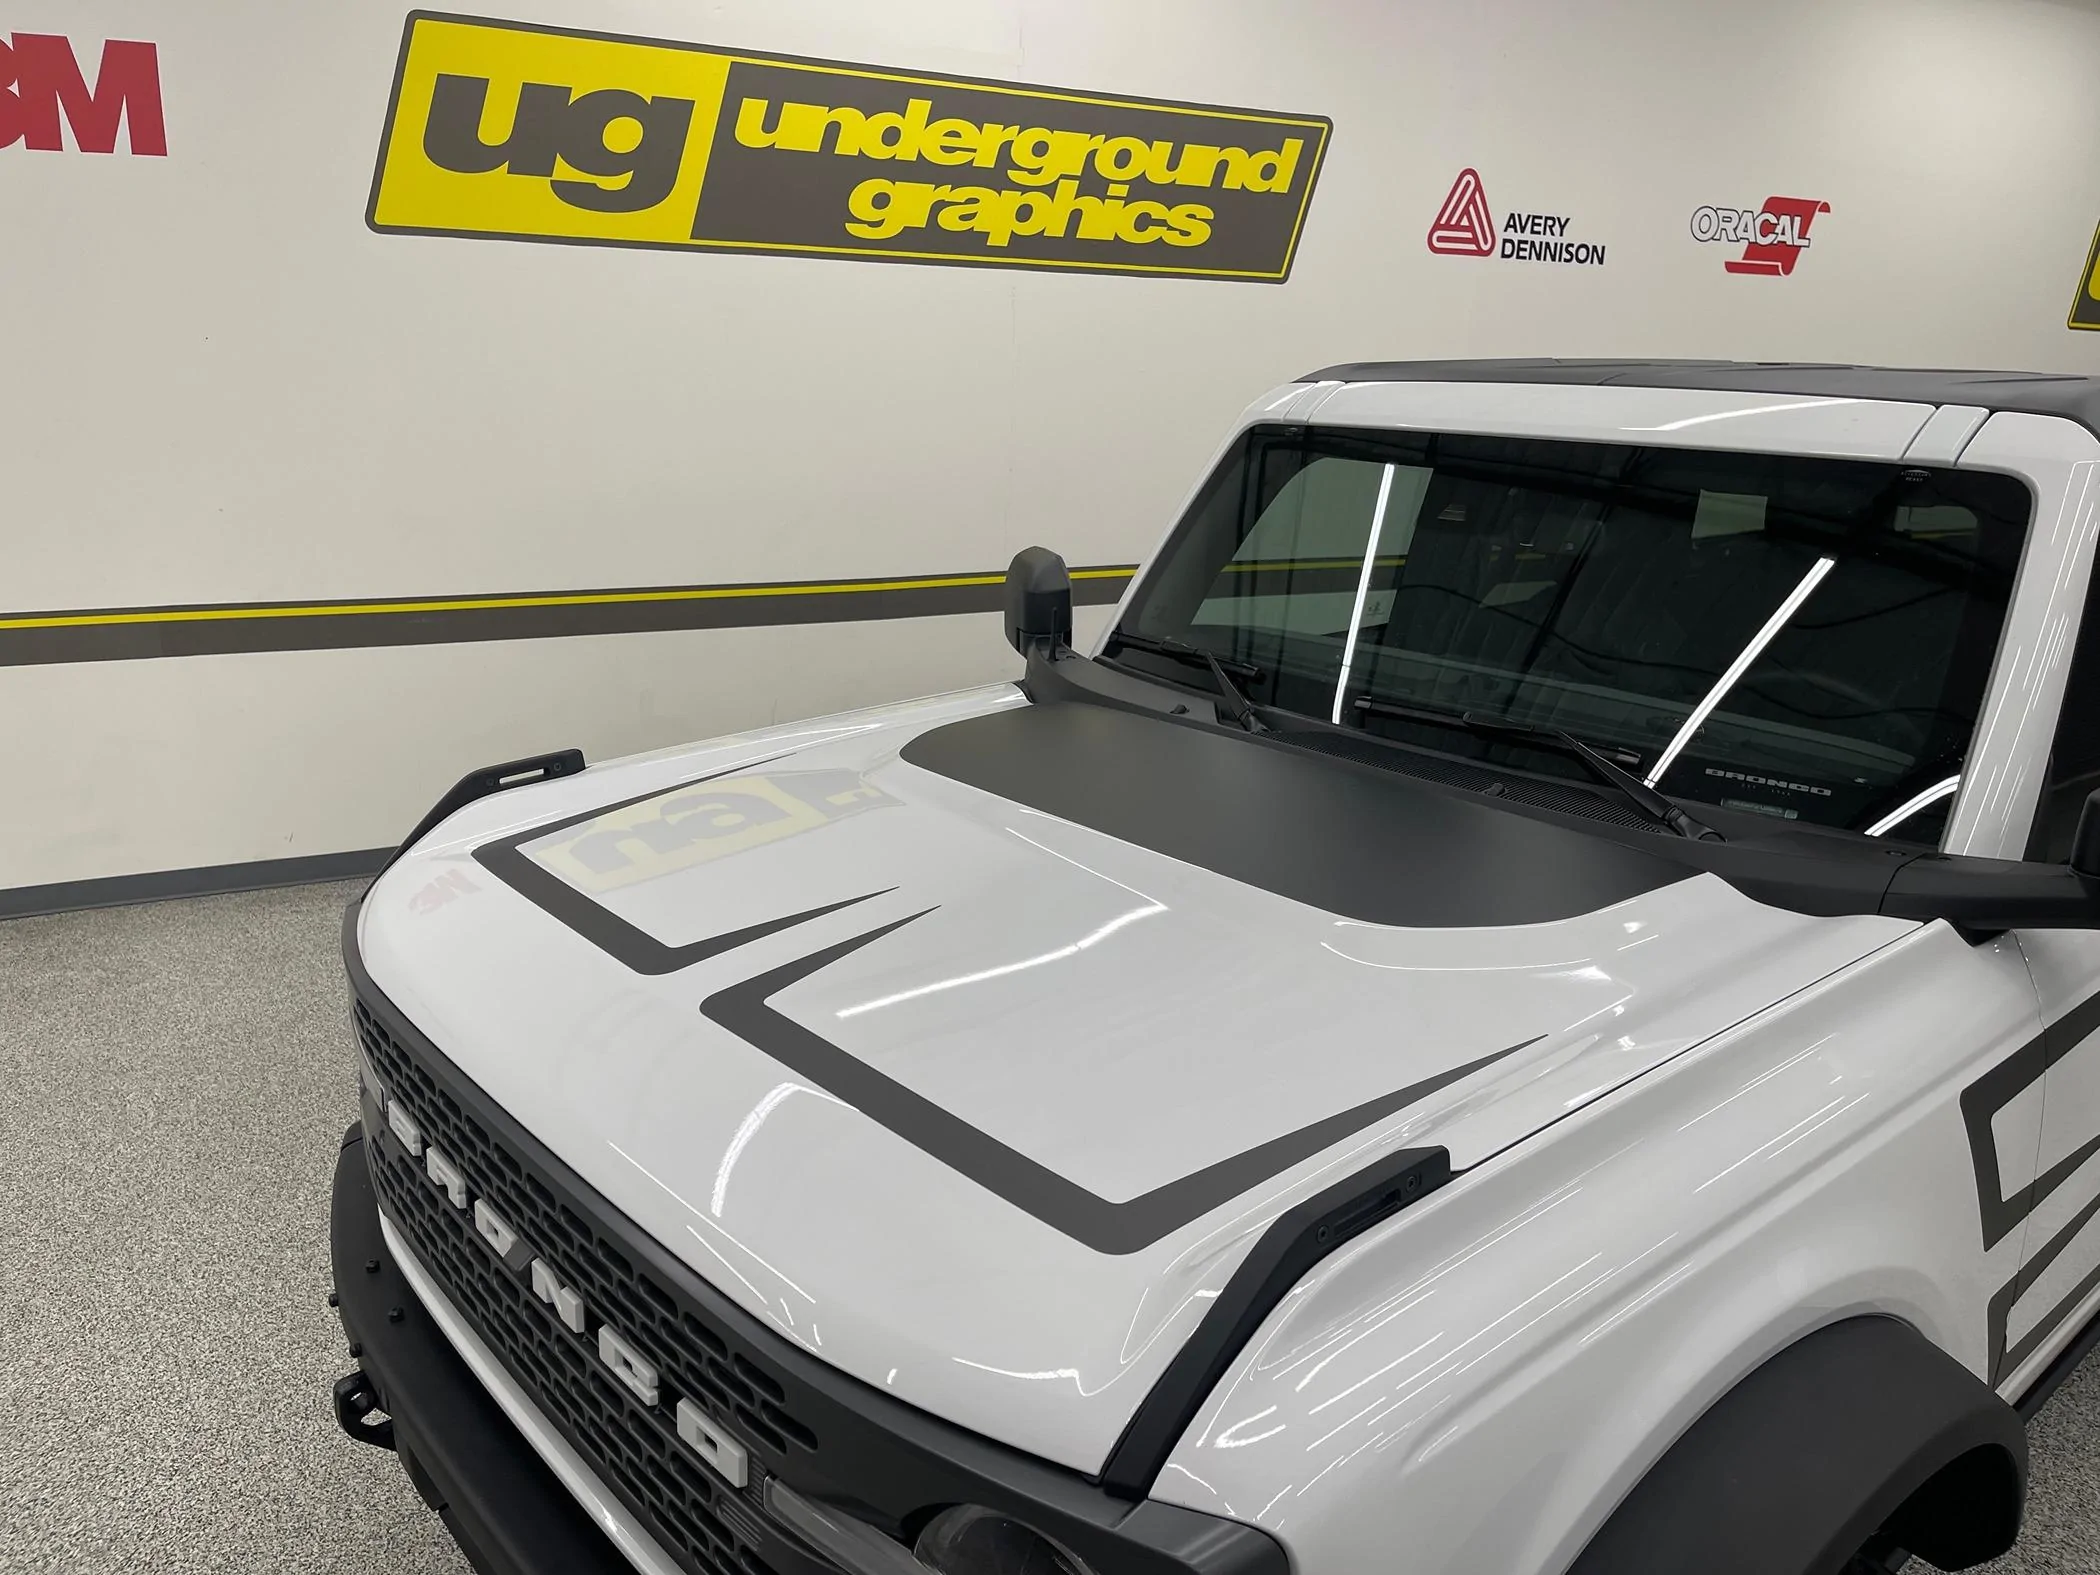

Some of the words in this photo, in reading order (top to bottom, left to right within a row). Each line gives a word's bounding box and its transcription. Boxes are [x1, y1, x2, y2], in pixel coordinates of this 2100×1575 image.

[422, 72, 696, 214] ug
[734, 97, 1304, 194] underground
[844, 177, 1215, 248] graphics
[1503, 212, 1571, 237] AVERY
[1690, 205, 1812, 248] ORACAL
[1500, 238, 1607, 266] DENNISON
[1705, 768, 1832, 796] BRONCO
[387, 1099, 749, 1489] BRONCO
